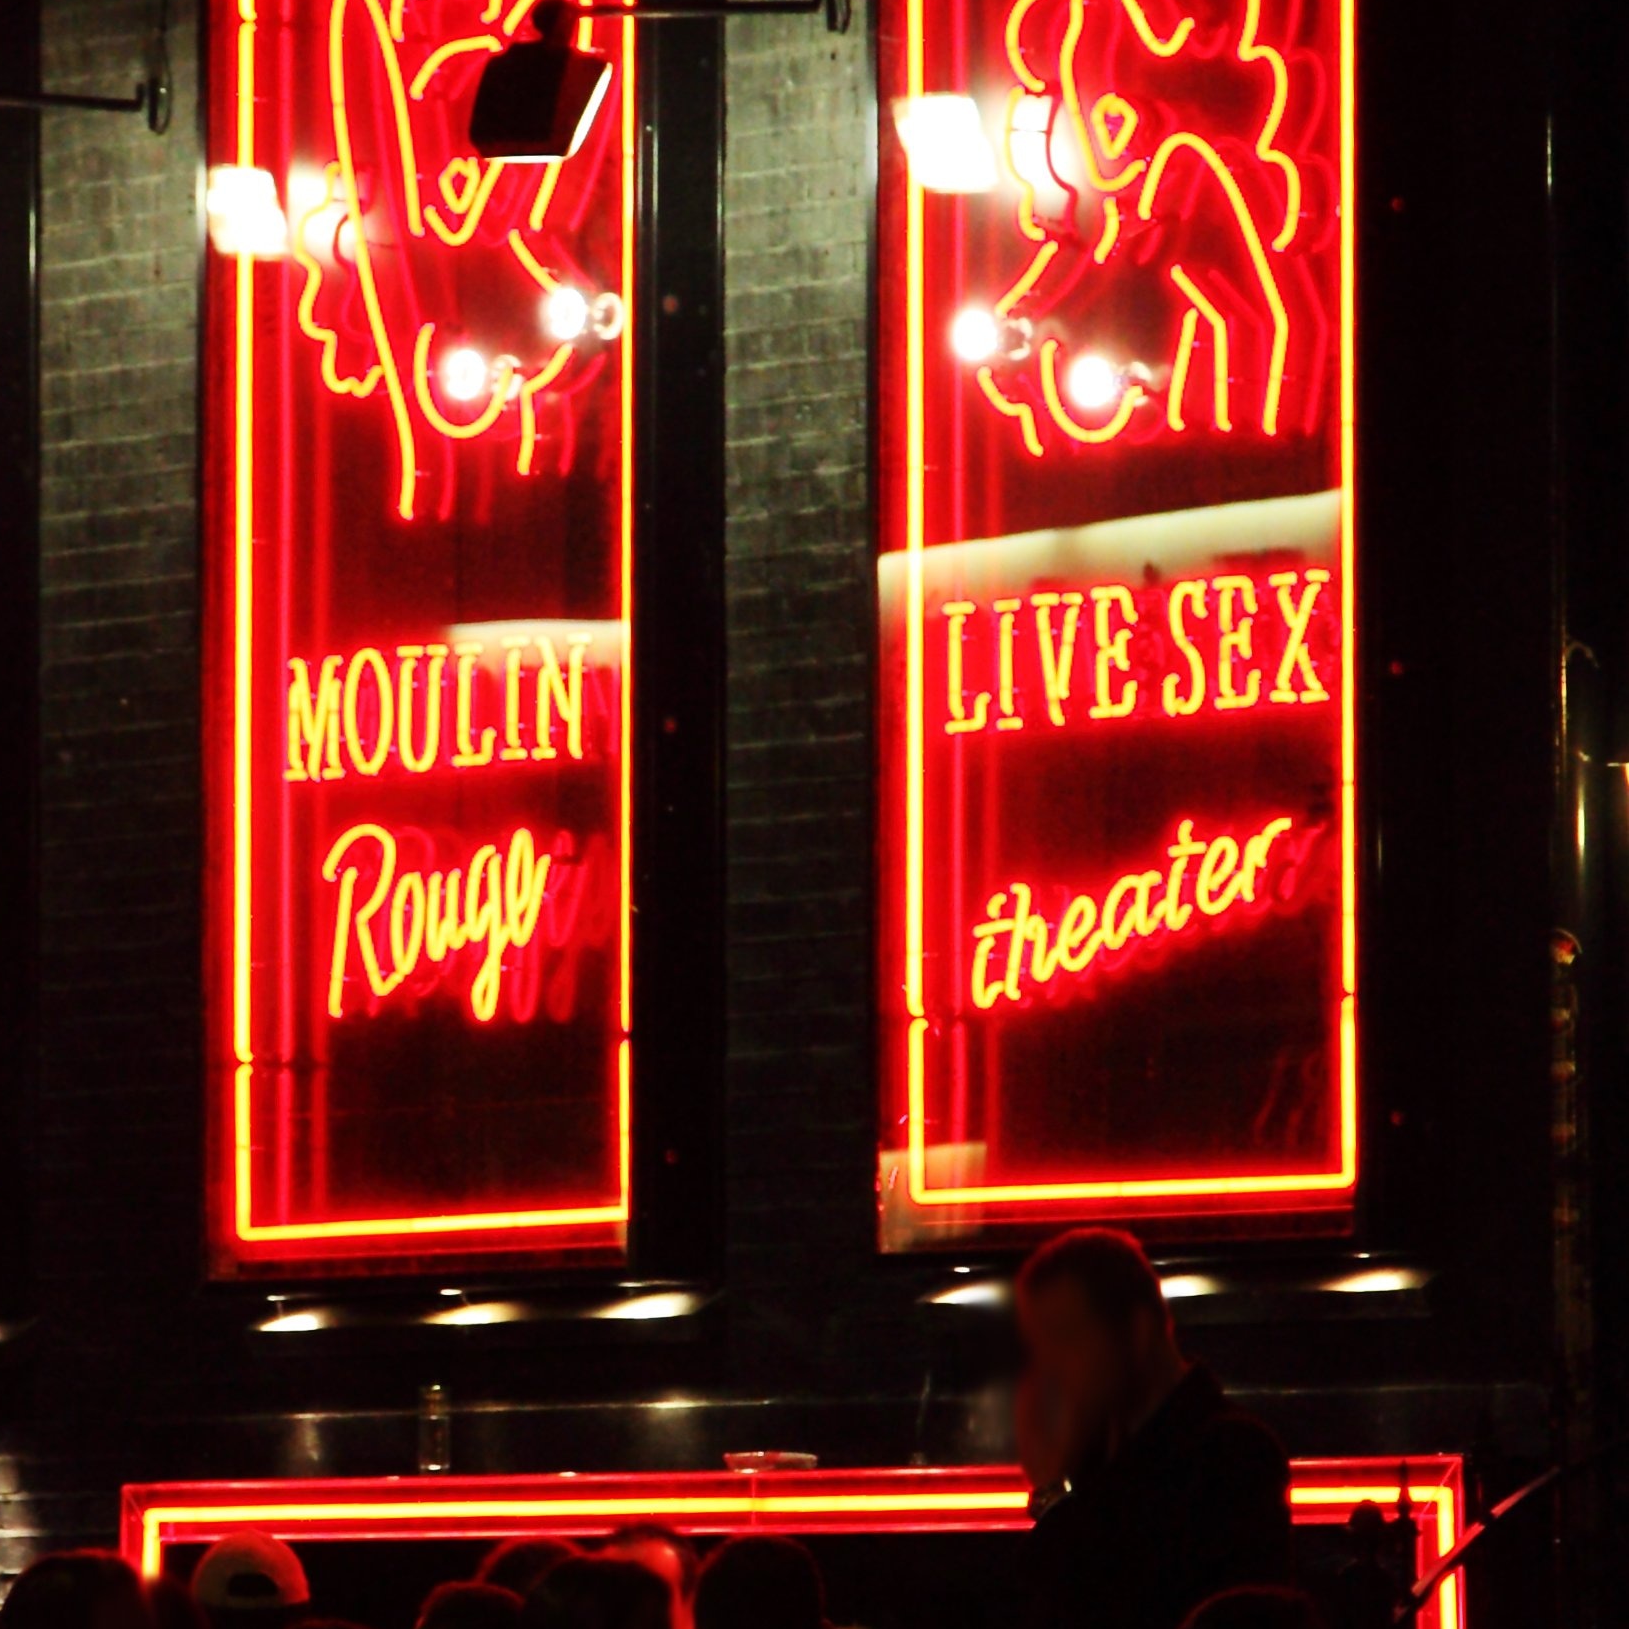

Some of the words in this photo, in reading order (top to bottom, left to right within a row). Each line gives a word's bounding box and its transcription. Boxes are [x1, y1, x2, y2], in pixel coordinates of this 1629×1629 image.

[282, 632, 594, 782] MOULIN
[941, 583, 1139, 735] LIVE
[1161, 567, 1331, 717] SEX
[321, 822, 552, 1023] Rouge
[970, 816, 1293, 1010] theater
